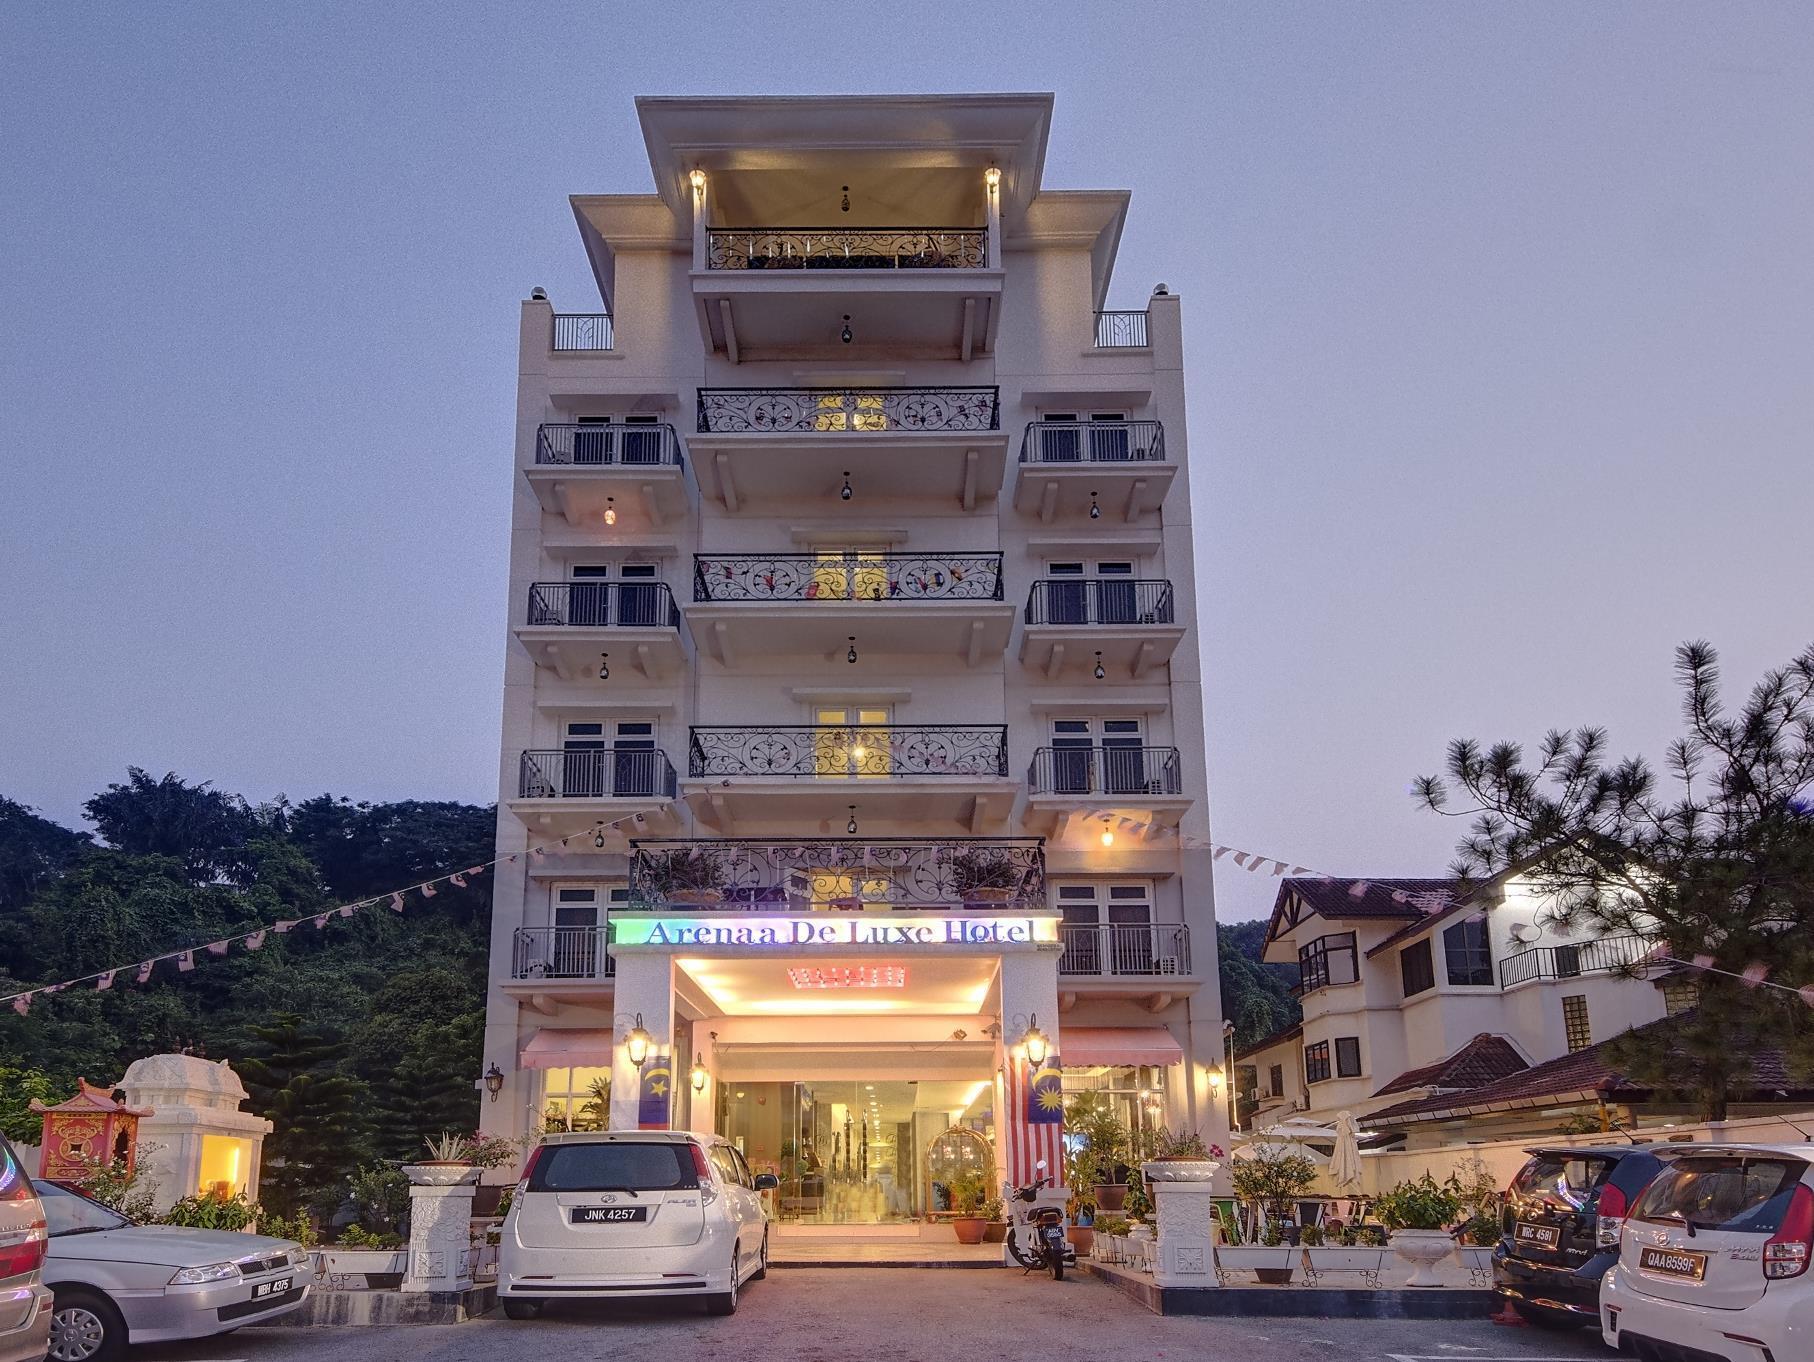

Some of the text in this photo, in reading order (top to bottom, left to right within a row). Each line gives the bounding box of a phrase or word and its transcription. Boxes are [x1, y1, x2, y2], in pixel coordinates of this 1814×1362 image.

[644, 919, 1036, 944] Arenaa De Luxe Hotel
[584, 1209, 636, 1220] JNK 4257
[1536, 1228, 1553, 1242] 4581
[1647, 1252, 1696, 1272] QAA8599F
[272, 1278, 289, 1292] 4375
